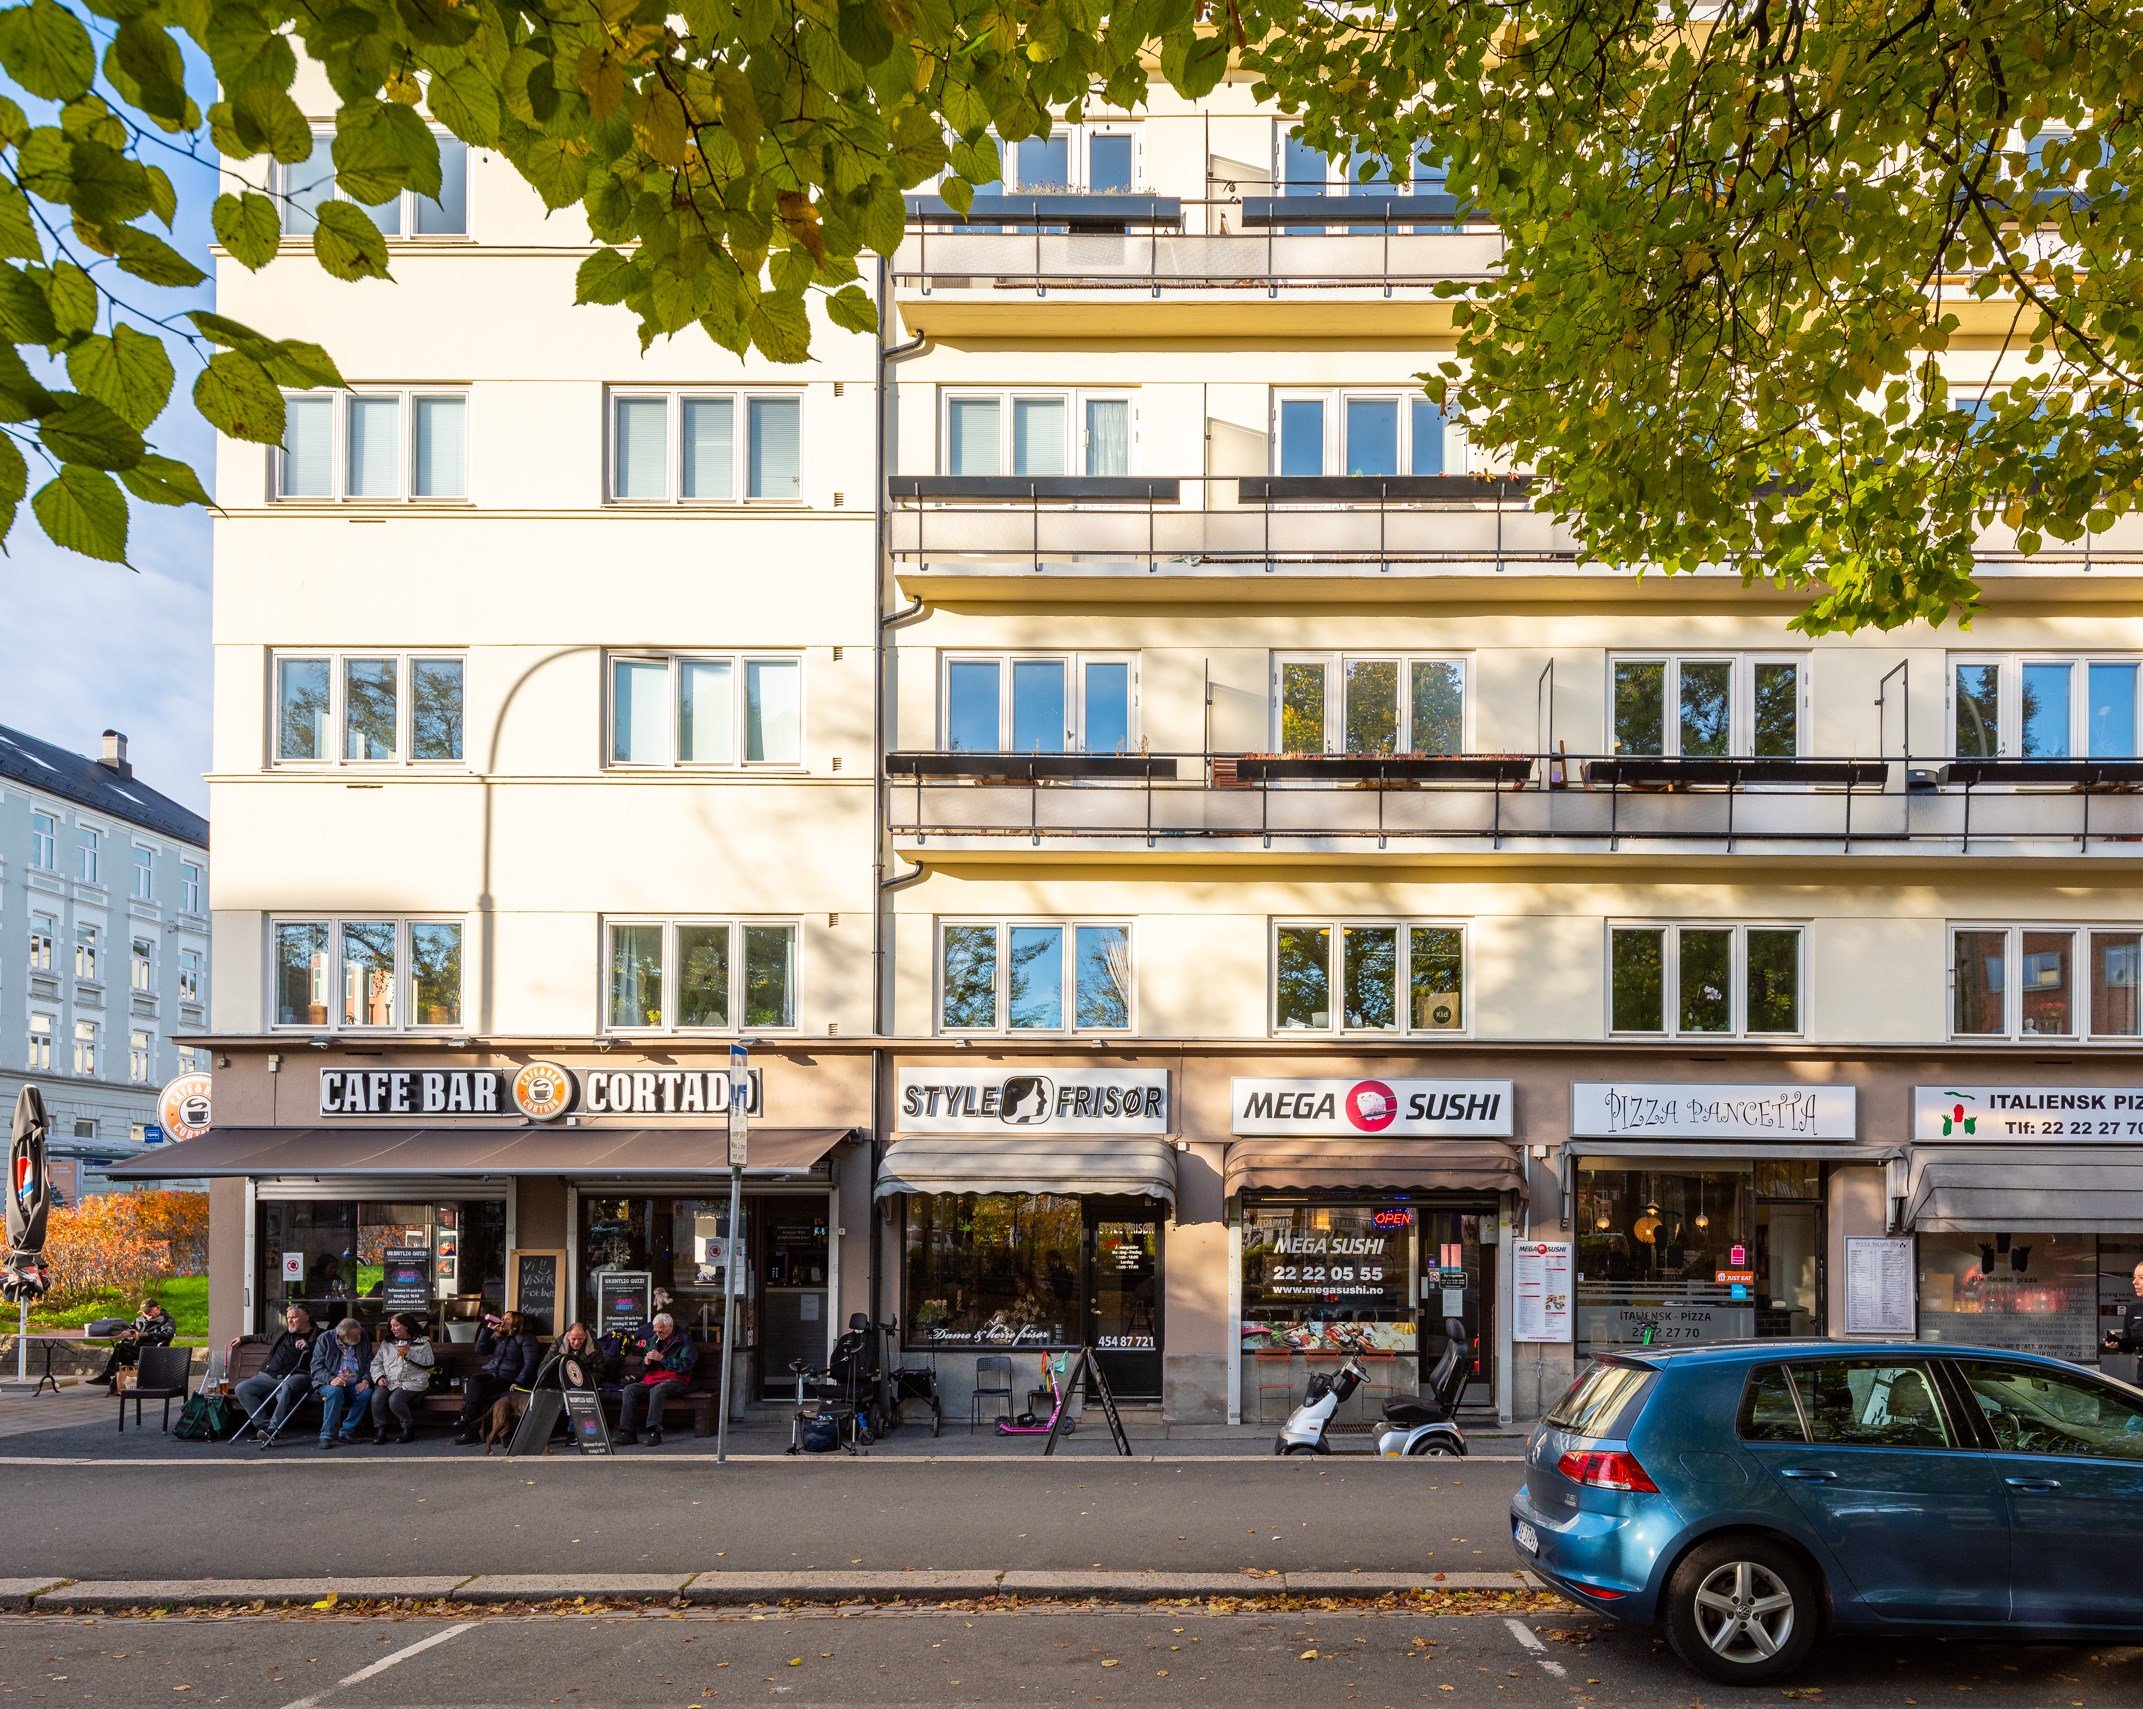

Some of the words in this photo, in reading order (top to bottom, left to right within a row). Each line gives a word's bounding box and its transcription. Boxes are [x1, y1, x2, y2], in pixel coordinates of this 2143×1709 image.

[321, 1072, 412, 1112] CAFE
[422, 1072, 496, 1112] BAR
[587, 1072, 752, 1112] CORTAD
[903, 1085, 1001, 1118] STYLE
[1056, 1085, 1162, 1118] FRISØR
[1243, 1092, 1336, 1120] MEGA
[1406, 1093, 1501, 1121] SUSHI
[1990, 1094, 2107, 1110] ITALIENSK
[1604, 1088, 1680, 1133] PIZZA
[1686, 1090, 1818, 1136] PANCETTA
[2005, 1121, 2036, 1135] Tlf:
[2041, 1122, 2064, 1135] 22
[2070, 1122, 2093, 1135] 22
[2098, 1122, 2120, 1136] 27
[1376, 1212, 1412, 1224] OPEN
[1274, 1238, 1326, 1254] MEGA
[1330, 1238, 1384, 1254] SUSHI
[1273, 1266, 1296, 1281] 22
[1302, 1266, 1326, 1281] 22
[1330, 1266, 1354, 1281] 05
[1360, 1267, 1383, 1281] 55
[1272, 1286, 1384, 1296] www.megasushi.no
[932, 1328, 971, 1340] Dame
[1666, 1328, 1680, 1337] 27
[1685, 1328, 1700, 1337] 70
[1098, 1336, 1118, 1347] 454
[1120, 1336, 1134, 1347] 87
[1135, 1336, 1154, 1347] 721
